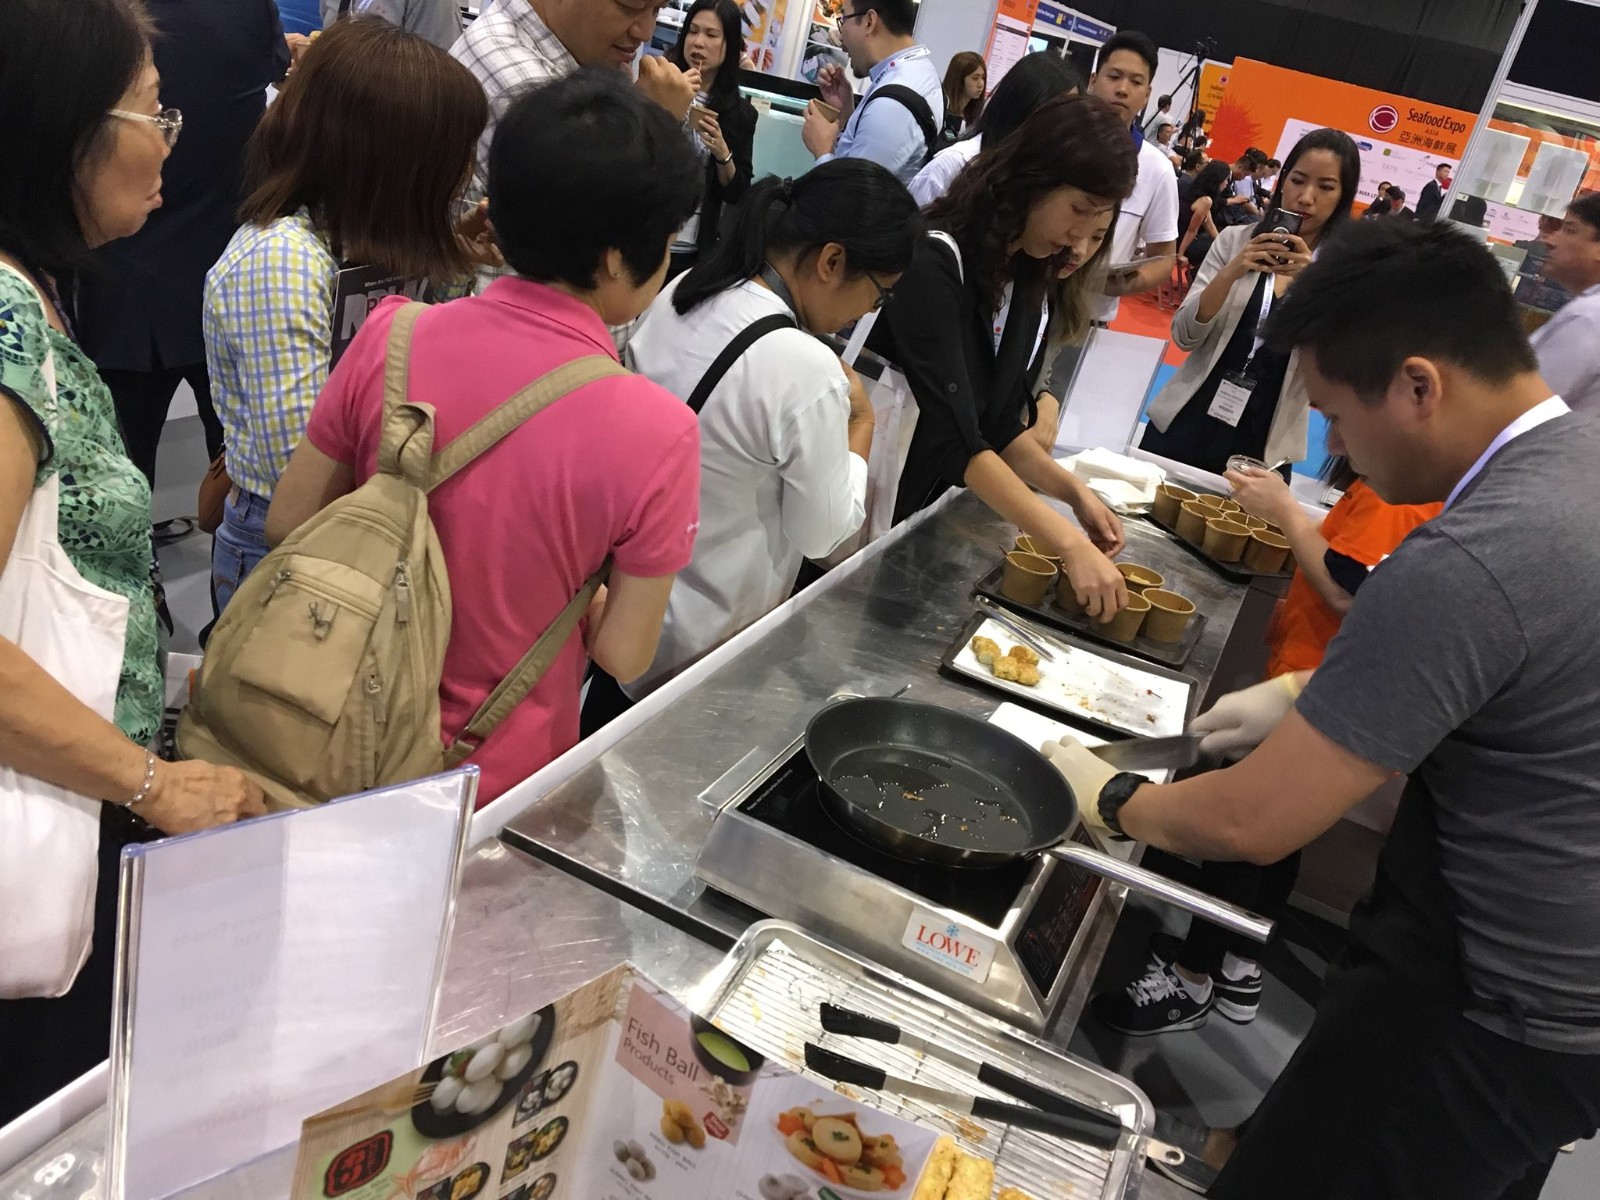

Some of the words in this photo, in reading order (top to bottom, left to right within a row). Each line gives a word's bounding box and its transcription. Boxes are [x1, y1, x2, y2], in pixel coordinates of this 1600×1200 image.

[1398, 130, 1458, 155] 亞洲海鮮展
[1406, 108, 1444, 128] Seafood
[1443, 117, 1466, 135] Expo
[917, 925, 981, 967] LOWE
[623, 1038, 675, 1084] Products
[627, 1018, 660, 1054] Fish
[666, 1047, 699, 1081] Ball
